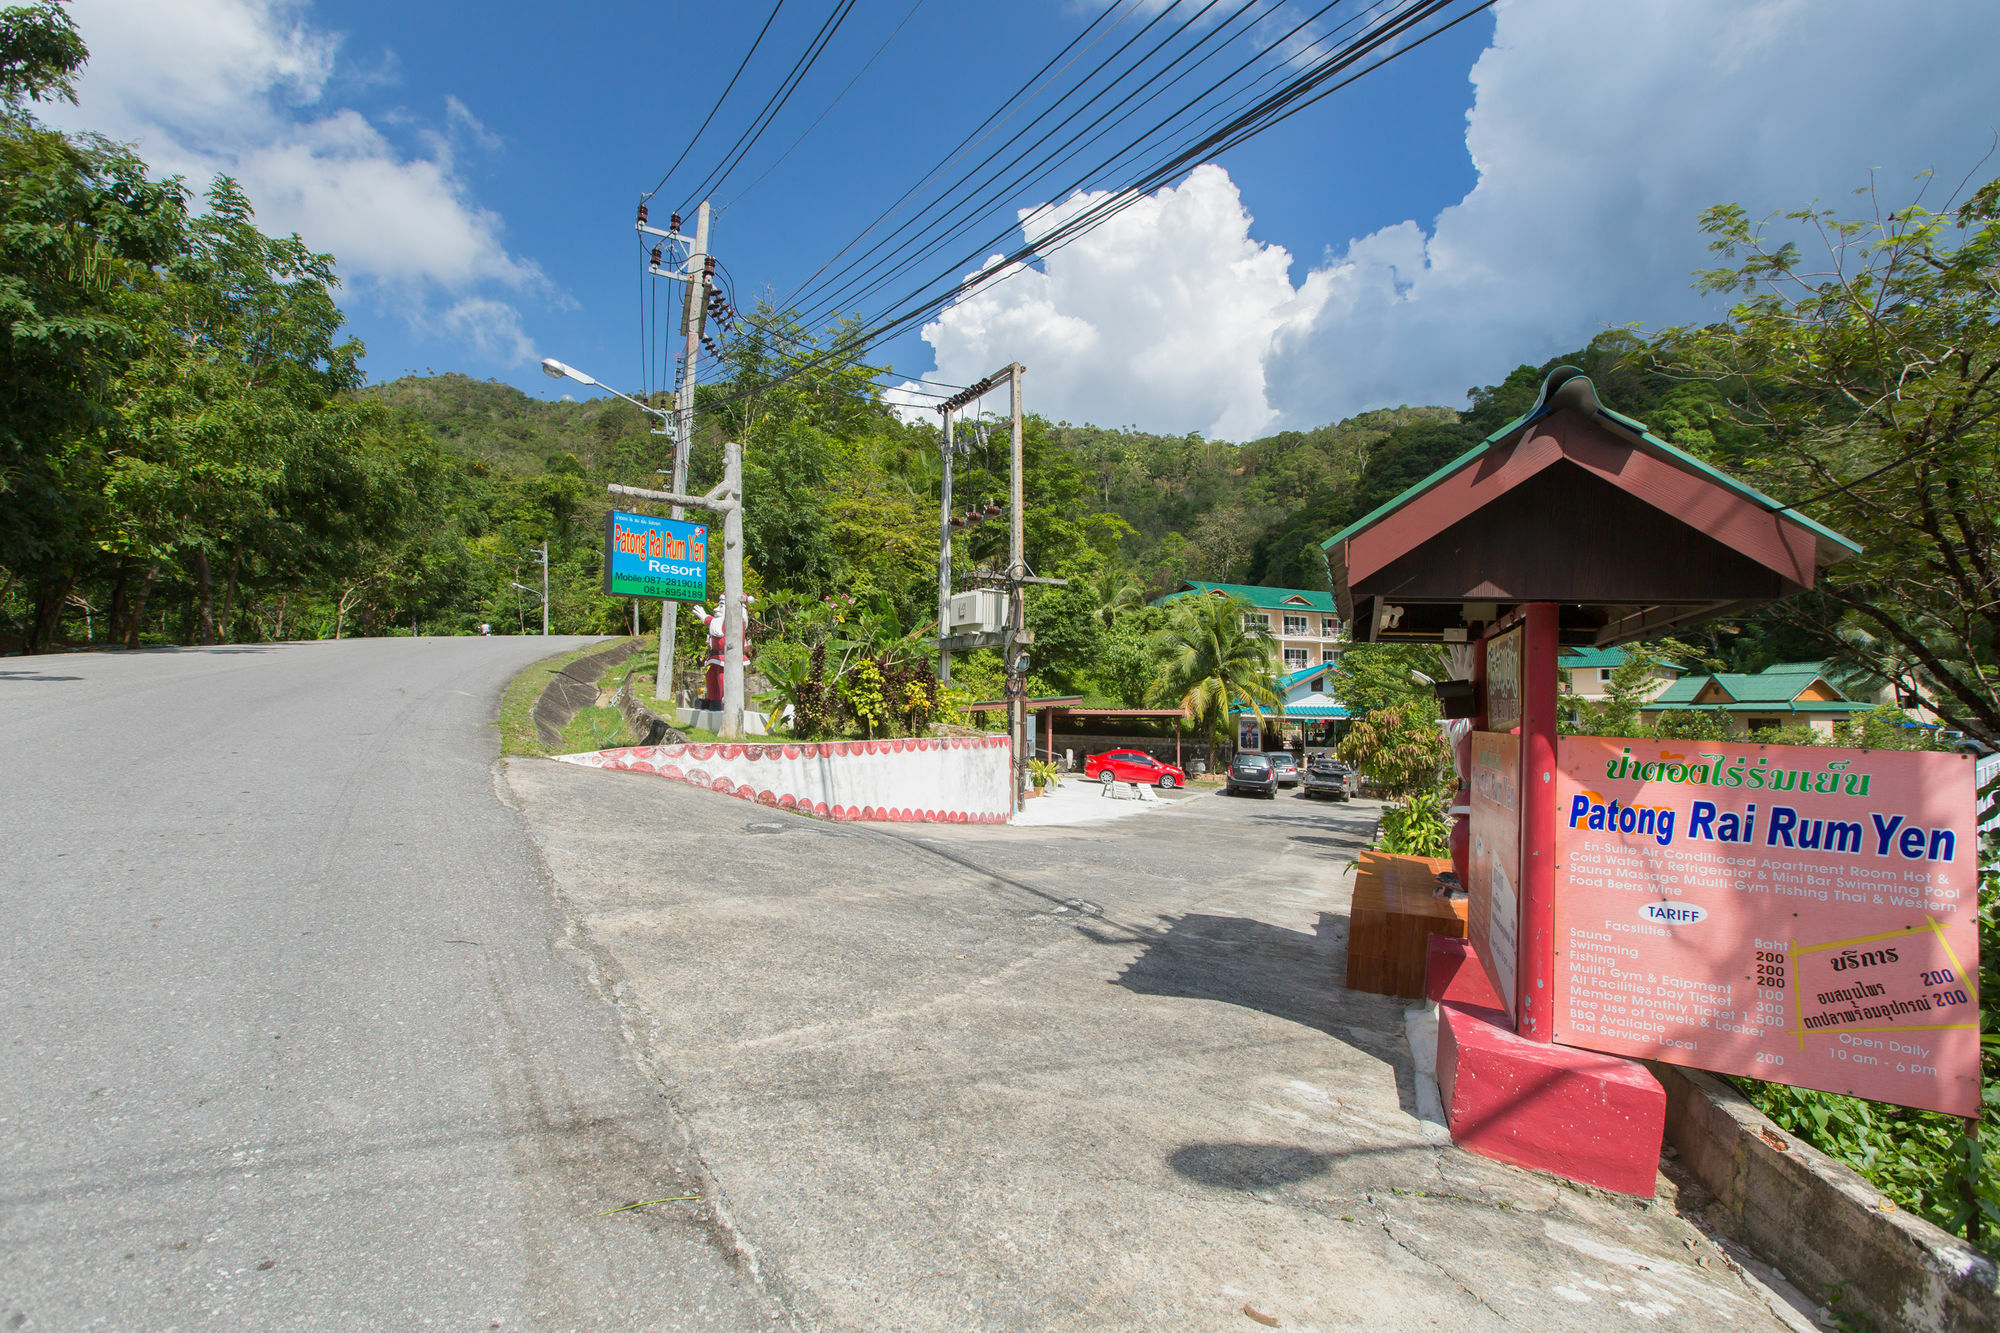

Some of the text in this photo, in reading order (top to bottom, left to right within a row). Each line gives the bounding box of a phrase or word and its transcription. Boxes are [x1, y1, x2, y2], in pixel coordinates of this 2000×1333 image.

[614, 524, 704, 562] Patong Rai Rum Yen
[649, 560, 702, 577] Resort
[644, 585, 703, 598] 081-8954189
[1568, 794, 1676, 846] Patong
[1687, 800, 1757, 845] Rai
[1765, 805, 1863, 855] Rum
[1869, 812, 1956, 863] Yen
[1584, 841, 1637, 855] En-Suite
[1641, 847, 1659, 857] Air
[1761, 858, 1844, 875] Apartment
[1850, 866, 1897, 880] Room
[1903, 871, 1931, 883] Hot
[1937, 873, 1950, 885] &
[1569, 852, 1960, 899] Cold Water TV Refrigerator & Mini Bar Swimming Pool
[1569, 875, 1682, 896] Food Beers Wine
[1570, 863, 1611, 876] Sauna
[1616, 868, 1679, 884] Massage
[1775, 884, 1828, 902] Fishing
[1833, 889, 1866, 903] Thai
[1873, 894, 1883, 904] &
[1889, 895, 1957, 912] Western
[1648, 906, 1700, 922] TARIFF
[1570, 927, 1612, 942] Sauna
[1570, 938, 1639, 959] Swimming
[1754, 938, 1788, 951] Baht
[1570, 950, 1615, 967] Fishing
[1756, 951, 1785, 964] 200
[1831, 948, 1899, 971] บริการ
[1610, 968, 1642, 982] Gym
[1647, 973, 1657, 983] &
[1756, 964, 1785, 977] 200
[1920, 969, 1954, 987] 200
[1570, 974, 1731, 1007] All Facilities Day Ticket
[1757, 976, 1785, 988] 200
[1570, 985, 1627, 1003] Member
[1631, 995, 1687, 1014] Monthly
[1693, 1004, 1735, 1020] Ticket
[1757, 988, 1784, 1001] 100
[1933, 990, 1968, 1007] 200
[1570, 996, 1765, 1037] Free use of Towels & Locker
[1756, 1001, 1784, 1015] 300
[1570, 1008, 1666, 1033] BBQ Available
[1571, 1020, 1596, 1033] Taxi
[1659, 1034, 1697, 1051] Local
[1840, 1033, 1930, 1059] Open Daily
[1756, 1052, 1784, 1066] 200
[1829, 1048, 1847, 1060] 10
[1852, 1054, 1878, 1065] am
[1896, 1062, 1905, 1072] 6
[1911, 1064, 1937, 1076] pm
